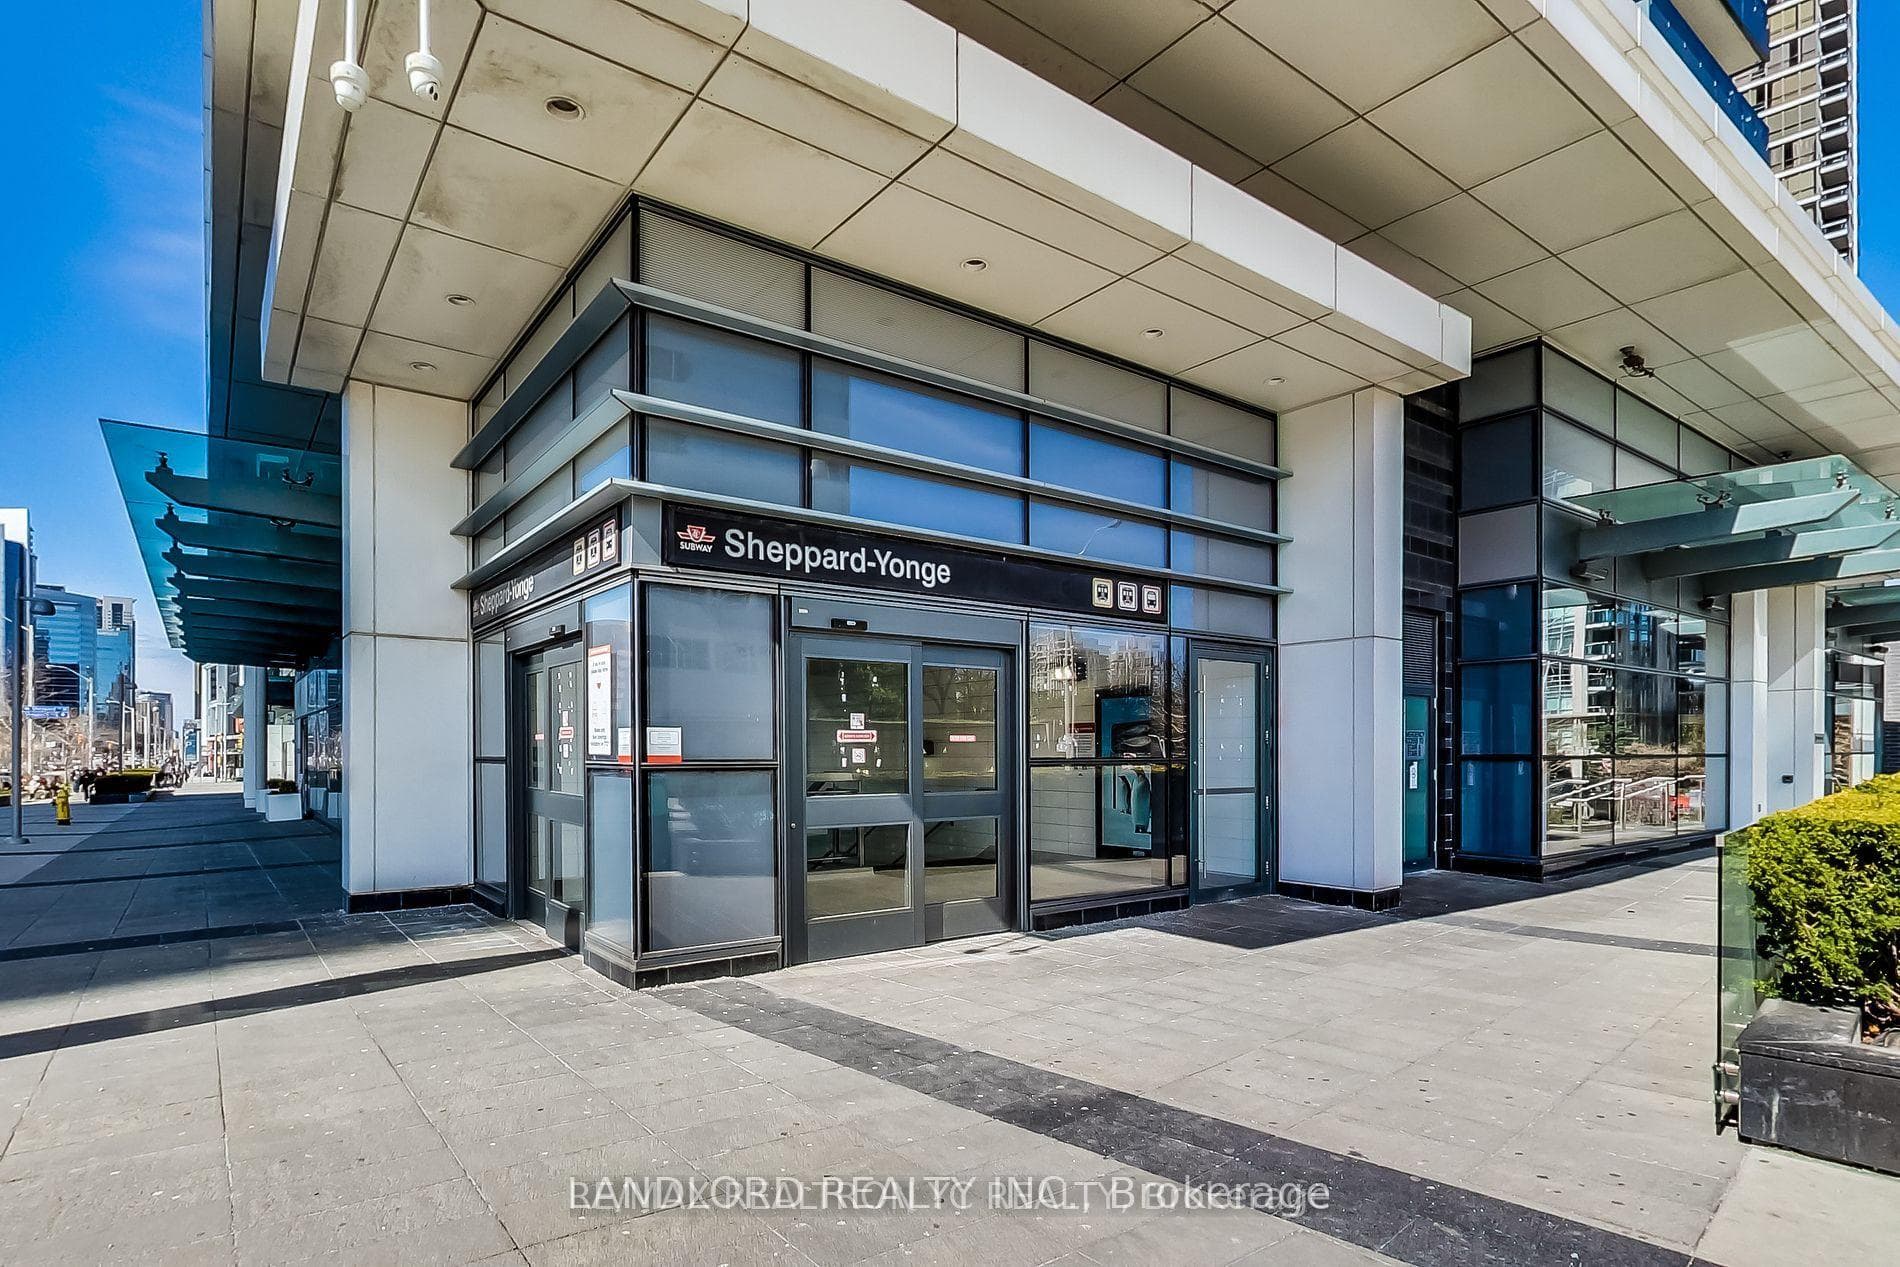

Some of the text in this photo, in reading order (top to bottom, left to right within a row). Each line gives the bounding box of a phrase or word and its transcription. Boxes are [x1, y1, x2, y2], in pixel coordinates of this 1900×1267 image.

[679, 541, 713, 553] SUBWAY
[724, 528, 952, 589] Sheppard-Yonge
[479, 575, 535, 616] Sheppard-Yonge
